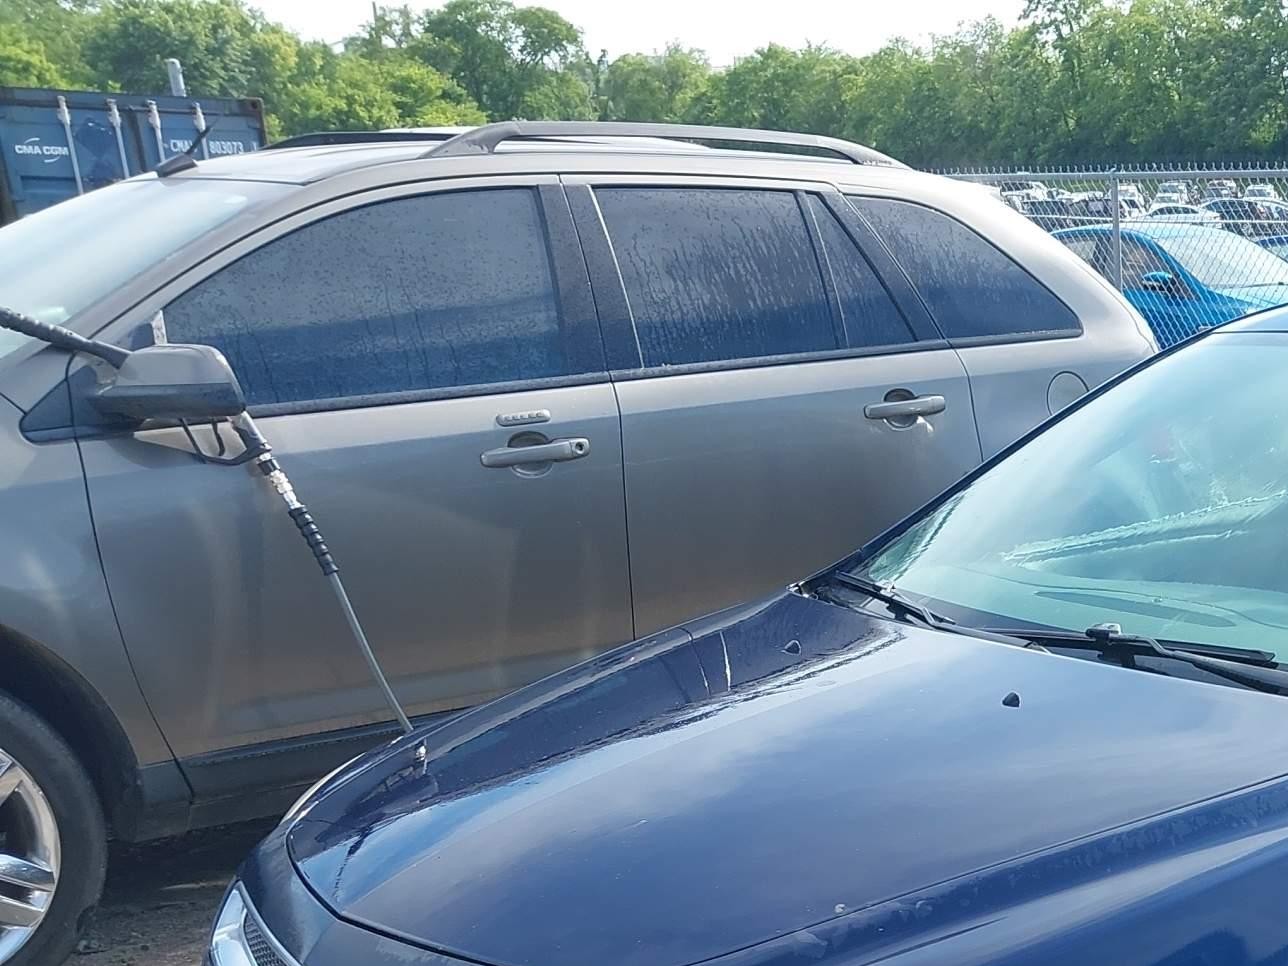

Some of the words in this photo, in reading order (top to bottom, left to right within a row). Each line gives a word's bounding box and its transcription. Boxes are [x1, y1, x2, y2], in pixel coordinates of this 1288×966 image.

[15, 144, 42, 155] CMA
[42, 145, 69, 156] CGM
[209, 140, 244, 154] 803073
